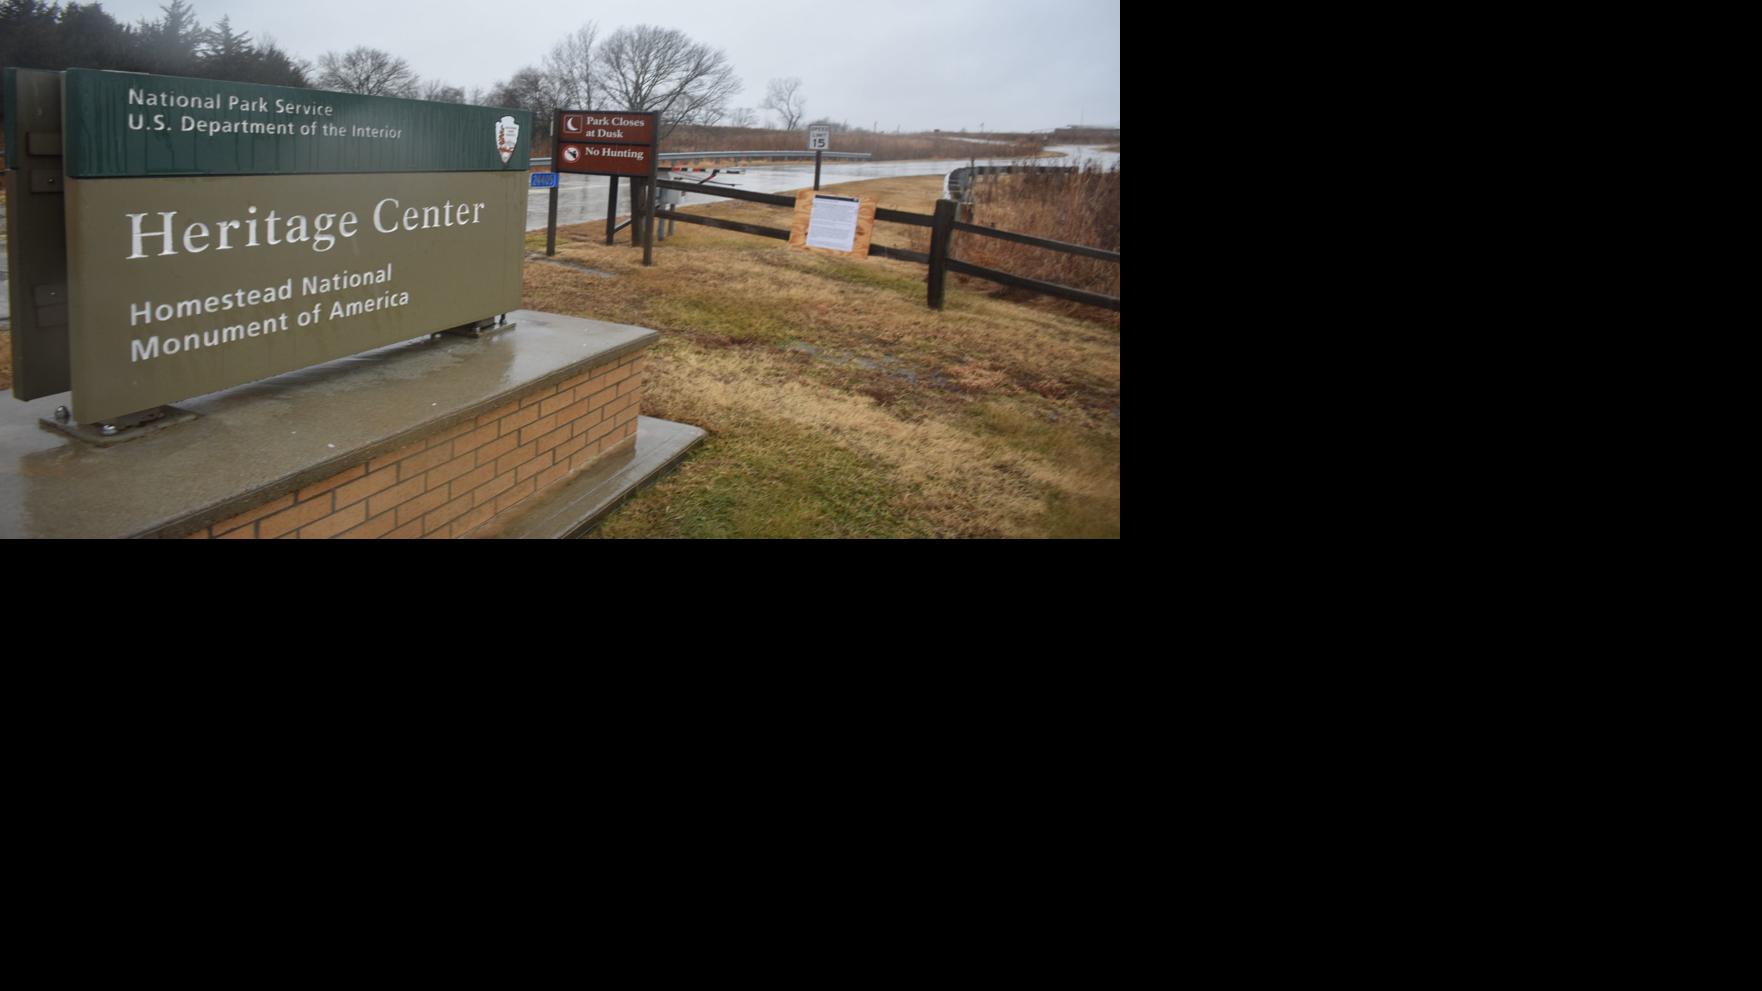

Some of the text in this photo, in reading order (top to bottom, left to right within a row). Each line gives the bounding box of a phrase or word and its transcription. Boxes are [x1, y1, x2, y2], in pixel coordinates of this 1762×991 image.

[128, 88, 333, 117] National Park Service
[128, 114, 402, 139] U.S. Department of the Interior
[585, 129, 624, 138] at Dusk
[586, 116, 645, 127] Park Closes
[585, 147, 644, 160] No Hunting
[813, 138, 826, 147] 15
[125, 197, 485, 260] Heritage Center
[131, 263, 393, 326] Homestead National
[131, 289, 409, 363] Monument of America
